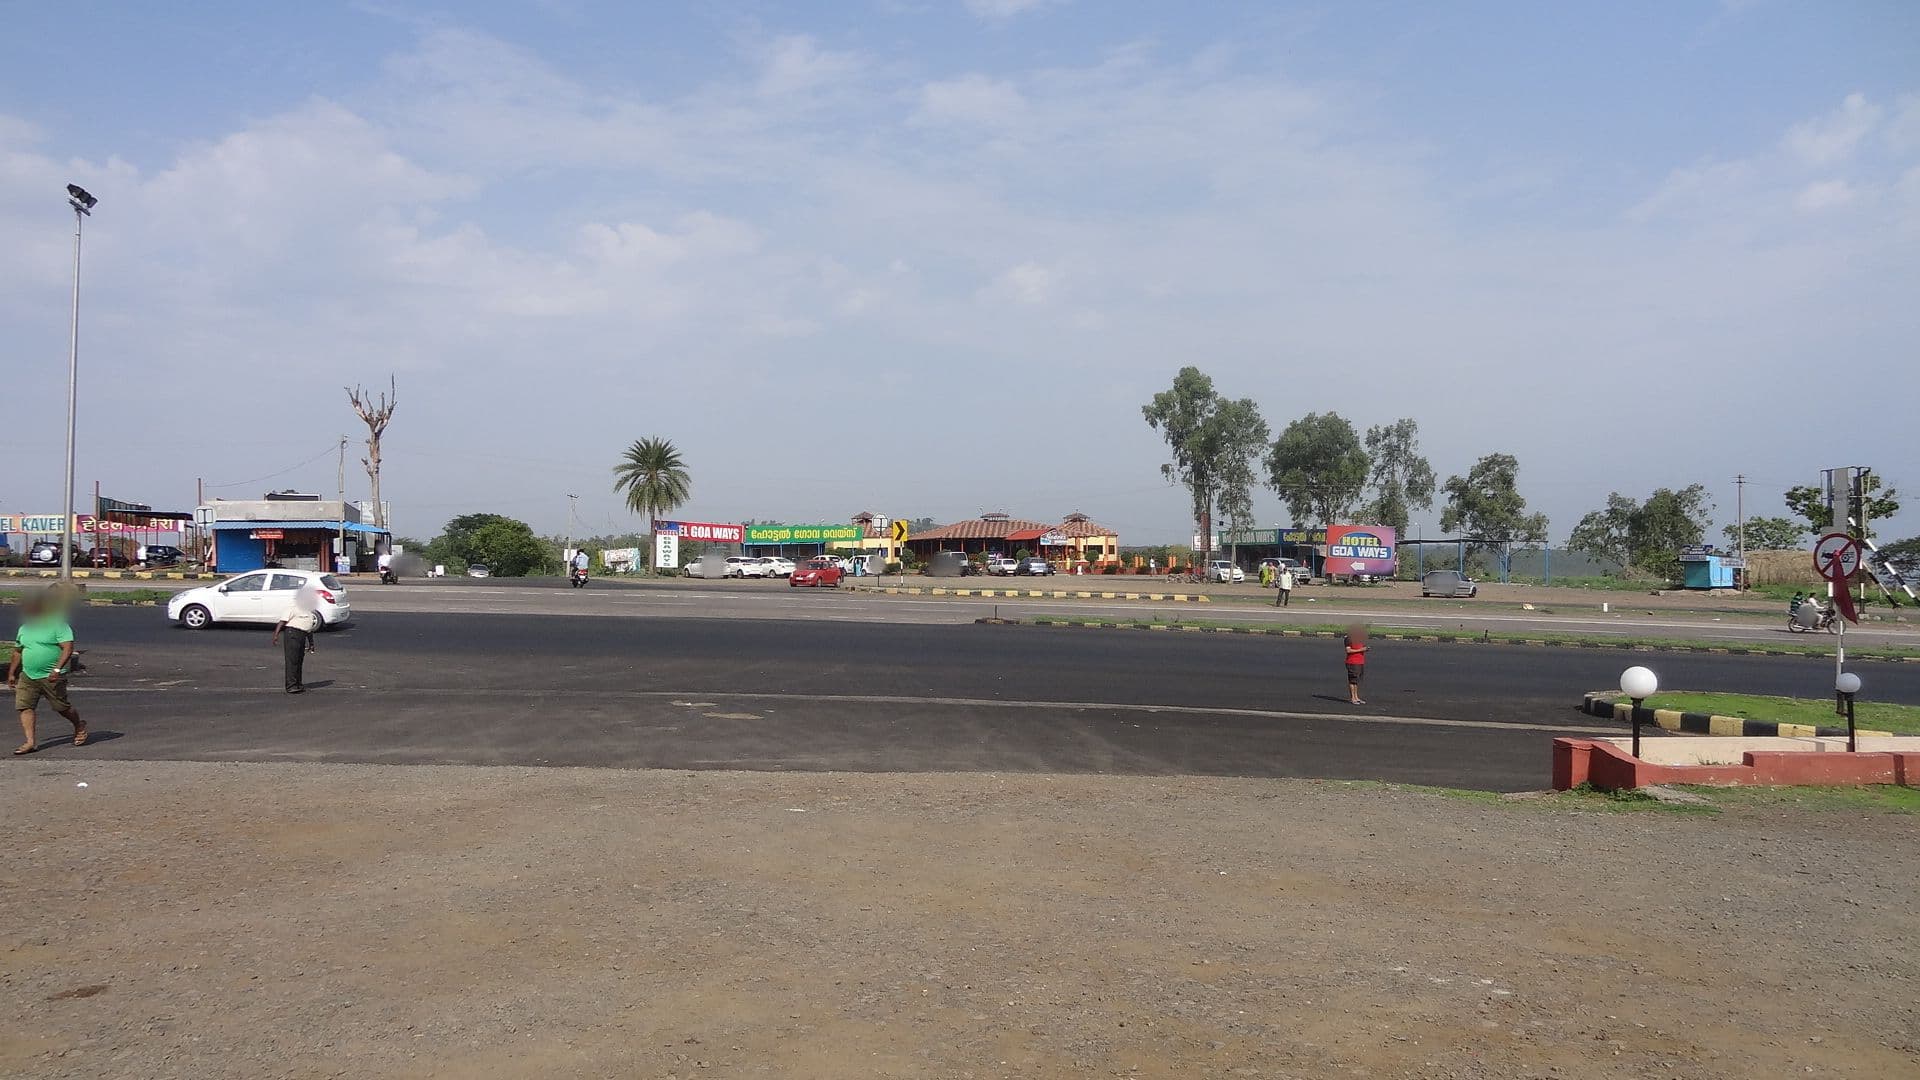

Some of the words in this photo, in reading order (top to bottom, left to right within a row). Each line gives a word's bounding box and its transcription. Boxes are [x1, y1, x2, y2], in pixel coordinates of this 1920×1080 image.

[691, 525, 711, 539] GOA
[713, 527, 739, 540] WAYS
[794, 529, 820, 539] ഗോവ
[1342, 536, 1379, 547] HOTEL
[1332, 546, 1354, 557] GOA
[1357, 547, 1388, 558] WAYS
